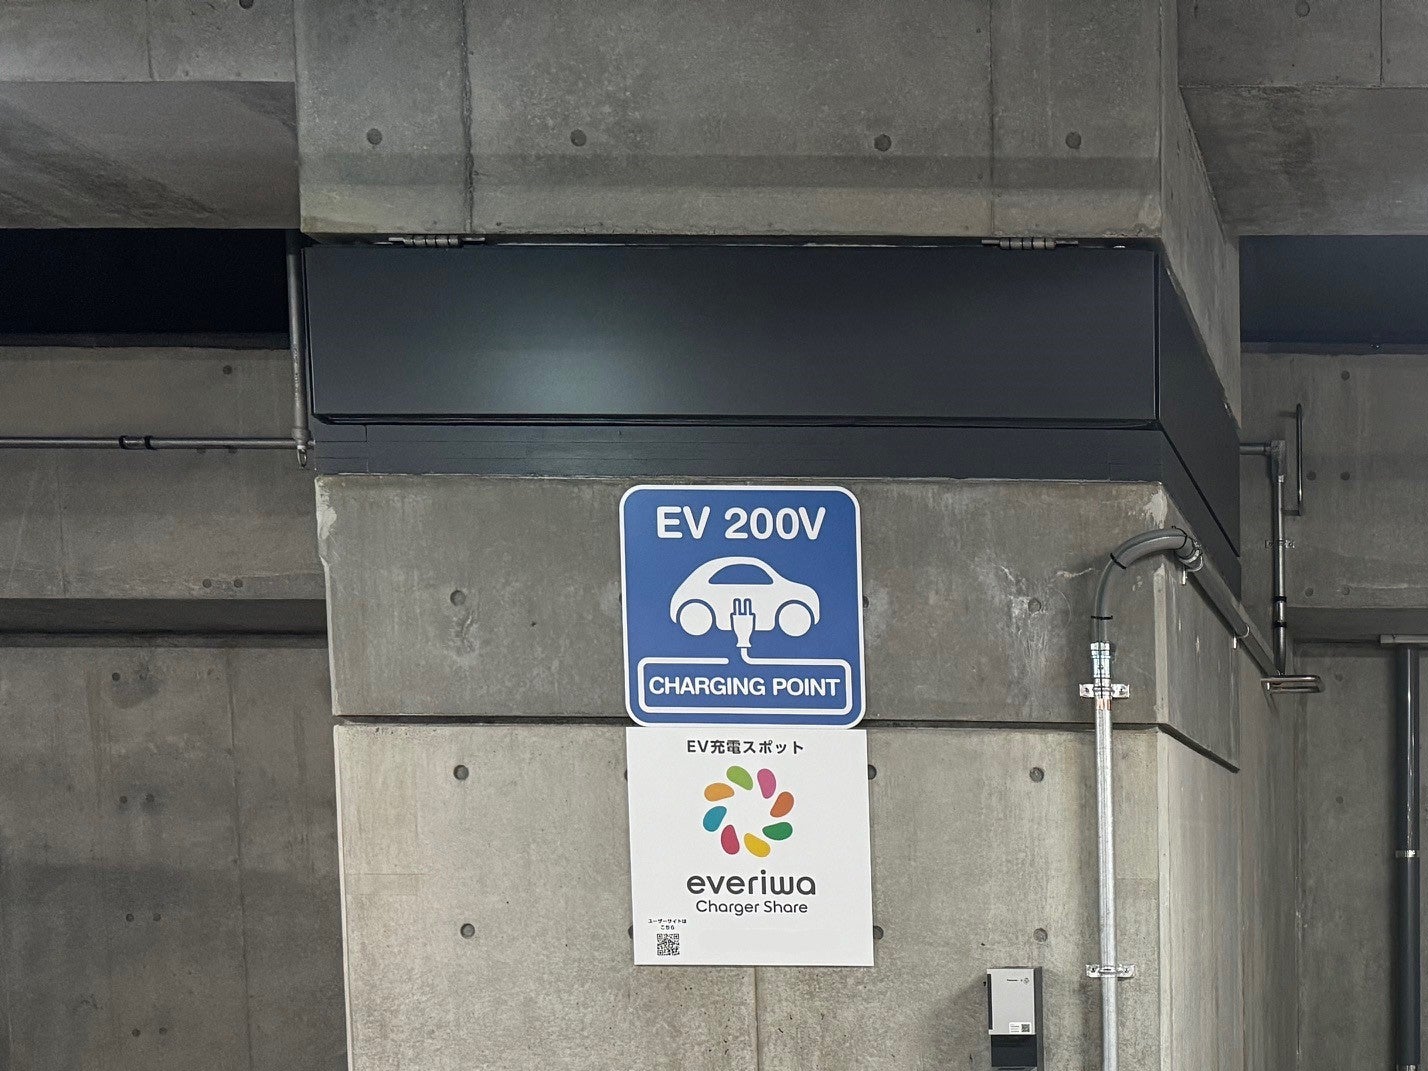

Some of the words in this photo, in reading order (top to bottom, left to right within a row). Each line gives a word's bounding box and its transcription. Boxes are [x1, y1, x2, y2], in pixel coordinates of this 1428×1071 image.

[656, 505, 711, 540] EV
[724, 506, 827, 541] 200V
[648, 676, 766, 696] CHARGING
[773, 677, 841, 697] POINT
[686, 738, 804, 755] EV充電スポット
[686, 869, 816, 896] everiwa
[695, 900, 760, 916] Charger
[763, 900, 809, 914] Share
